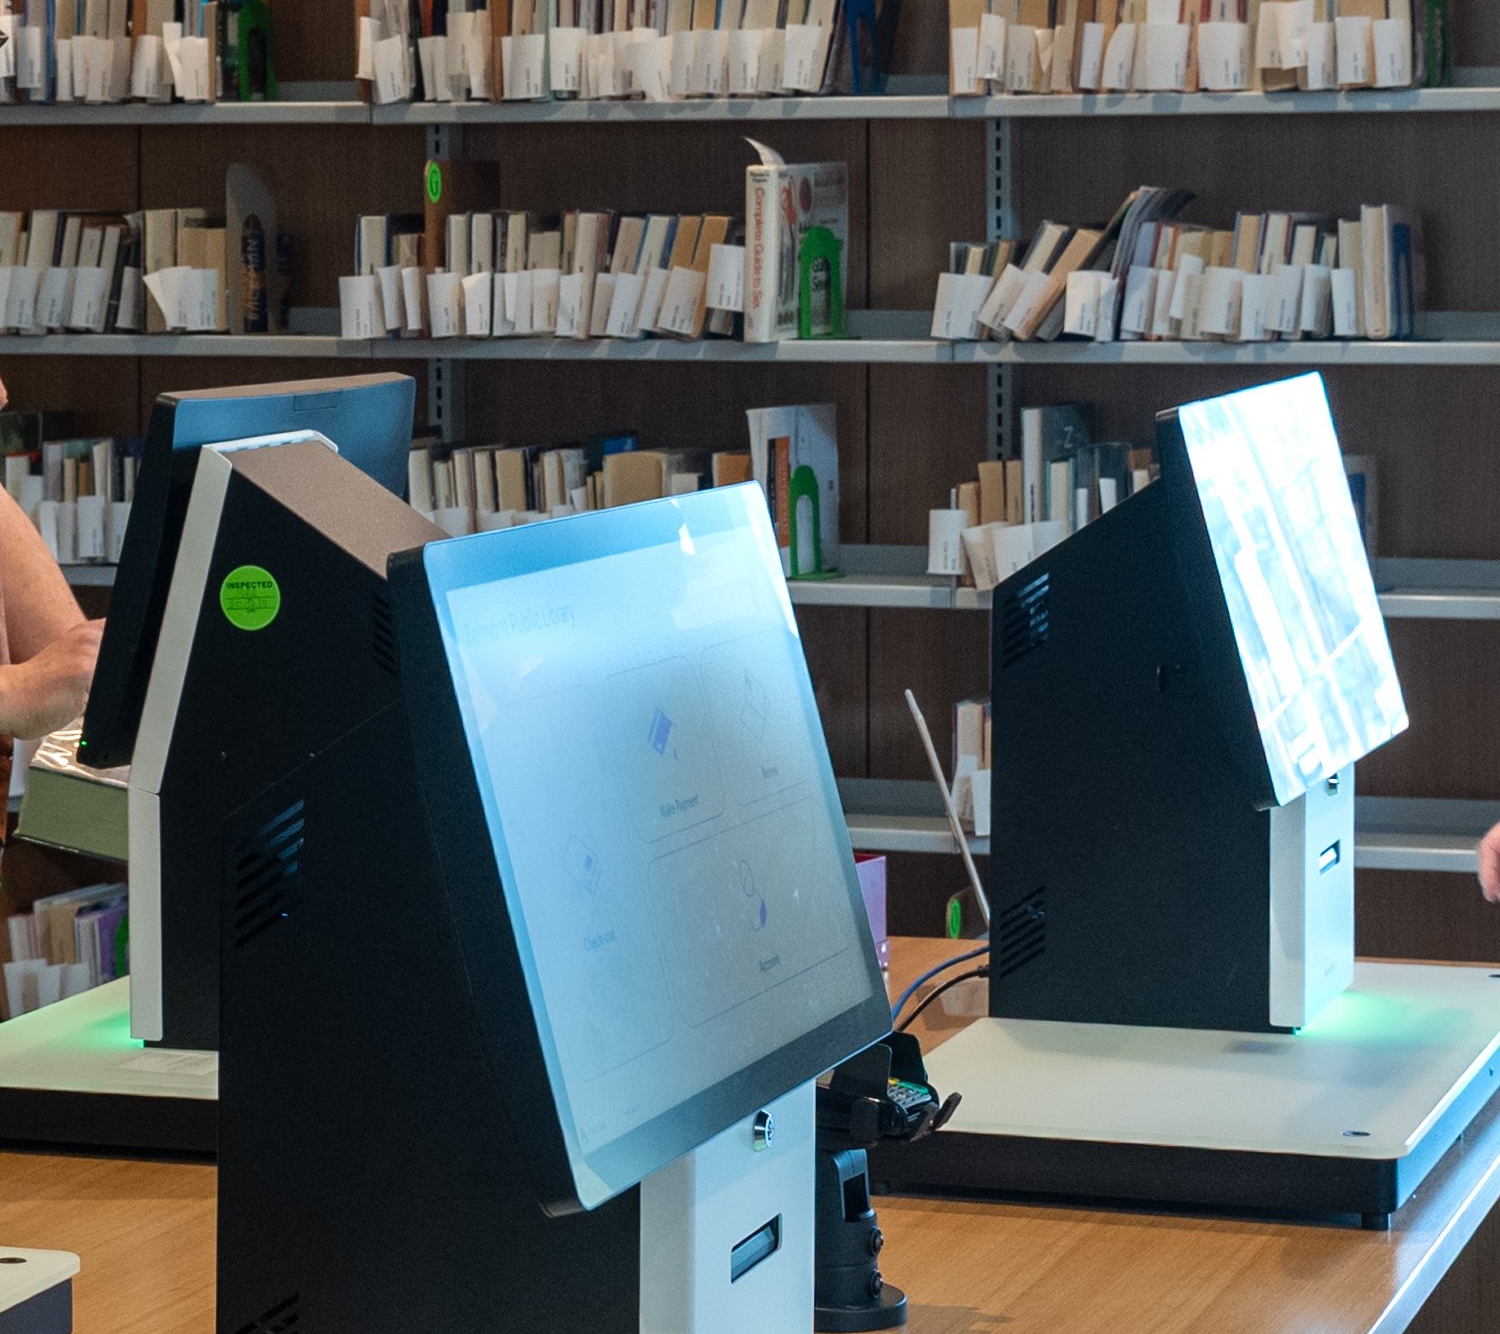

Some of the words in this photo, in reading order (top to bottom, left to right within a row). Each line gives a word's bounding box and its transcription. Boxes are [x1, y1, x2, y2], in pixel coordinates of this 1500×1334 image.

[226, 581, 273, 589] INSPECTED
[508, 609, 541, 638] Public
[540, 604, 576, 633] Library
